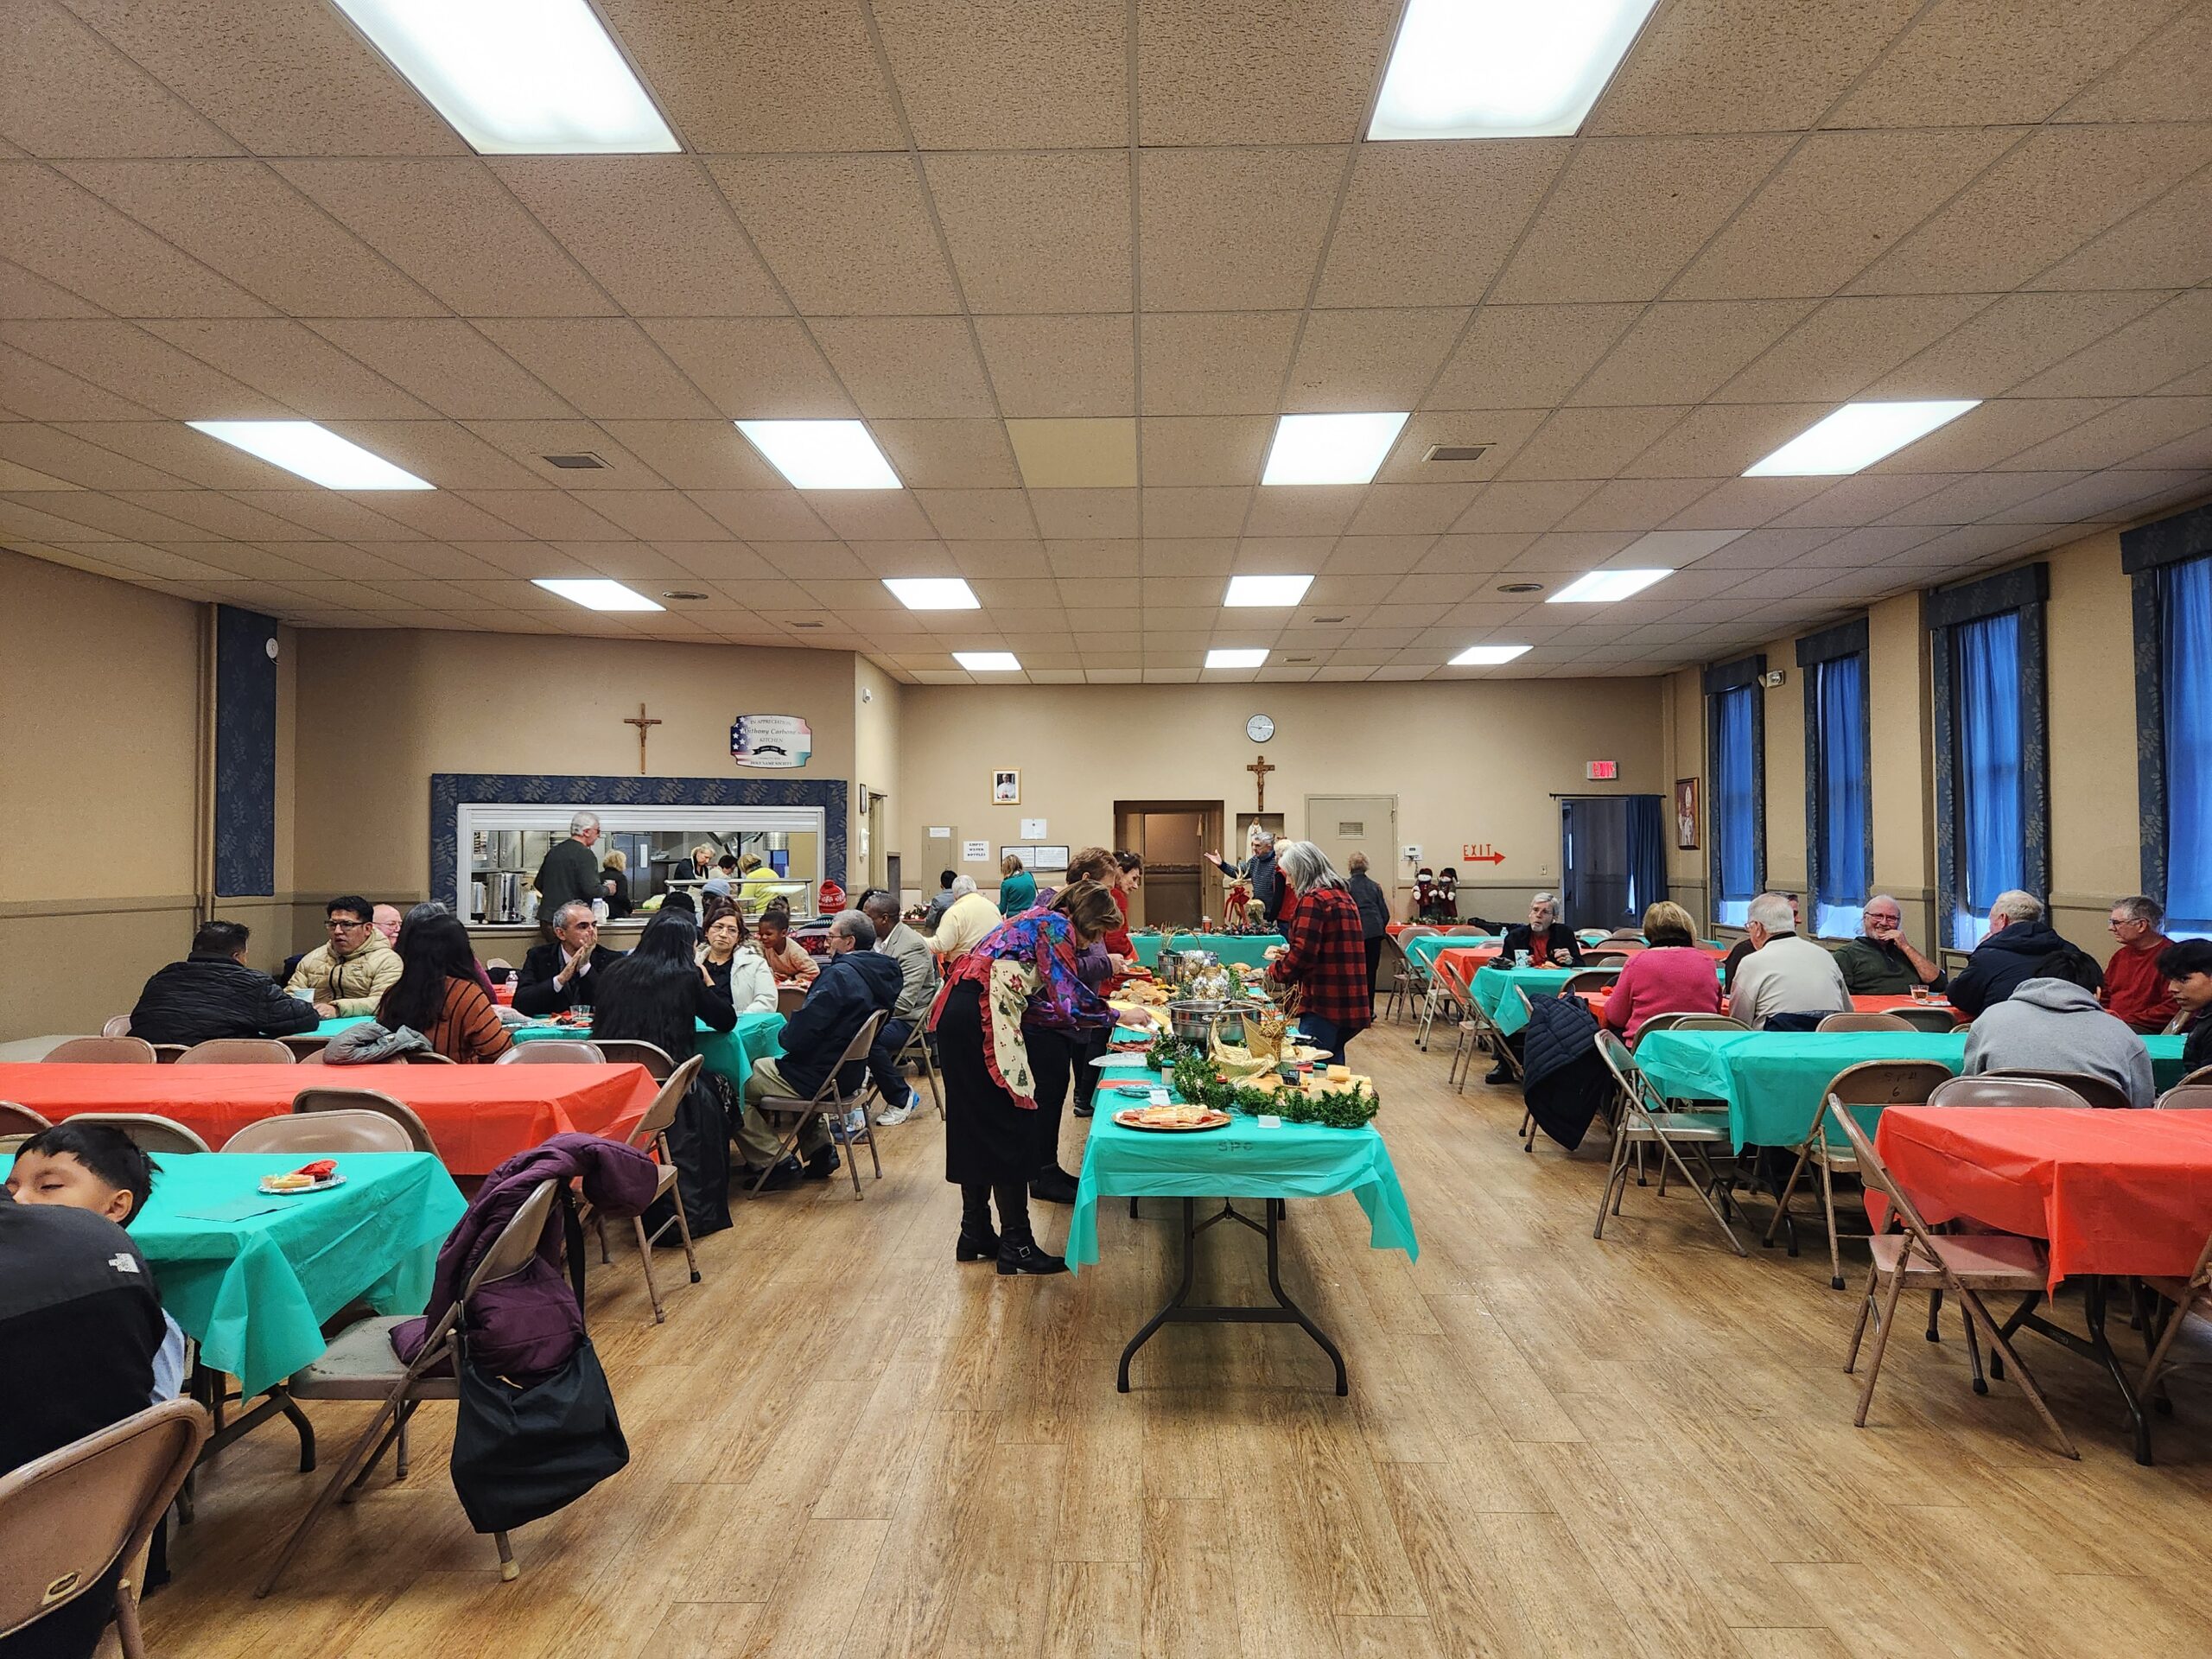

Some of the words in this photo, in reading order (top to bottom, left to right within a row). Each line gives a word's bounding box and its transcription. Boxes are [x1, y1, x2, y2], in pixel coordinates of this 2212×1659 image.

[1592, 761, 1614, 777] EXIT
[1463, 843, 1491, 856] EXIT
[1892, 1086, 1900, 1097] 6
